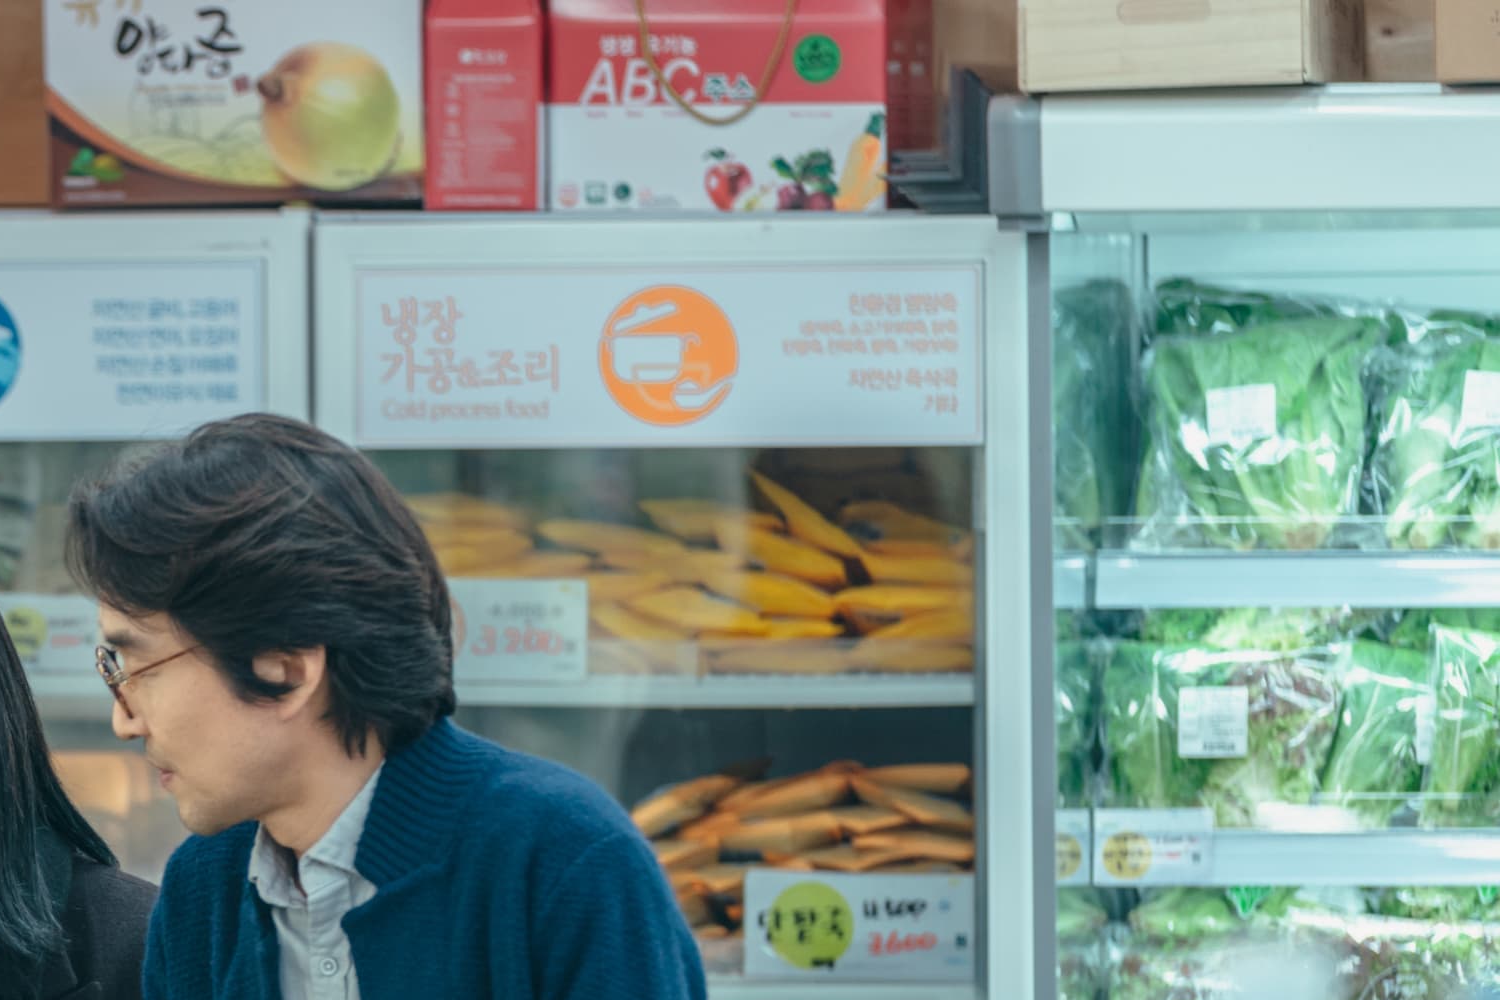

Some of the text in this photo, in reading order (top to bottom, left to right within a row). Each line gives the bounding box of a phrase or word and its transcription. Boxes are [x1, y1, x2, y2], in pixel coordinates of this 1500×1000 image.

[578, 58, 699, 109] ABC
[380, 295, 464, 345] 냉장
[380, 344, 560, 394] 가공&조리
[382, 398, 426, 421] Cold
[504, 398, 551, 421] food
